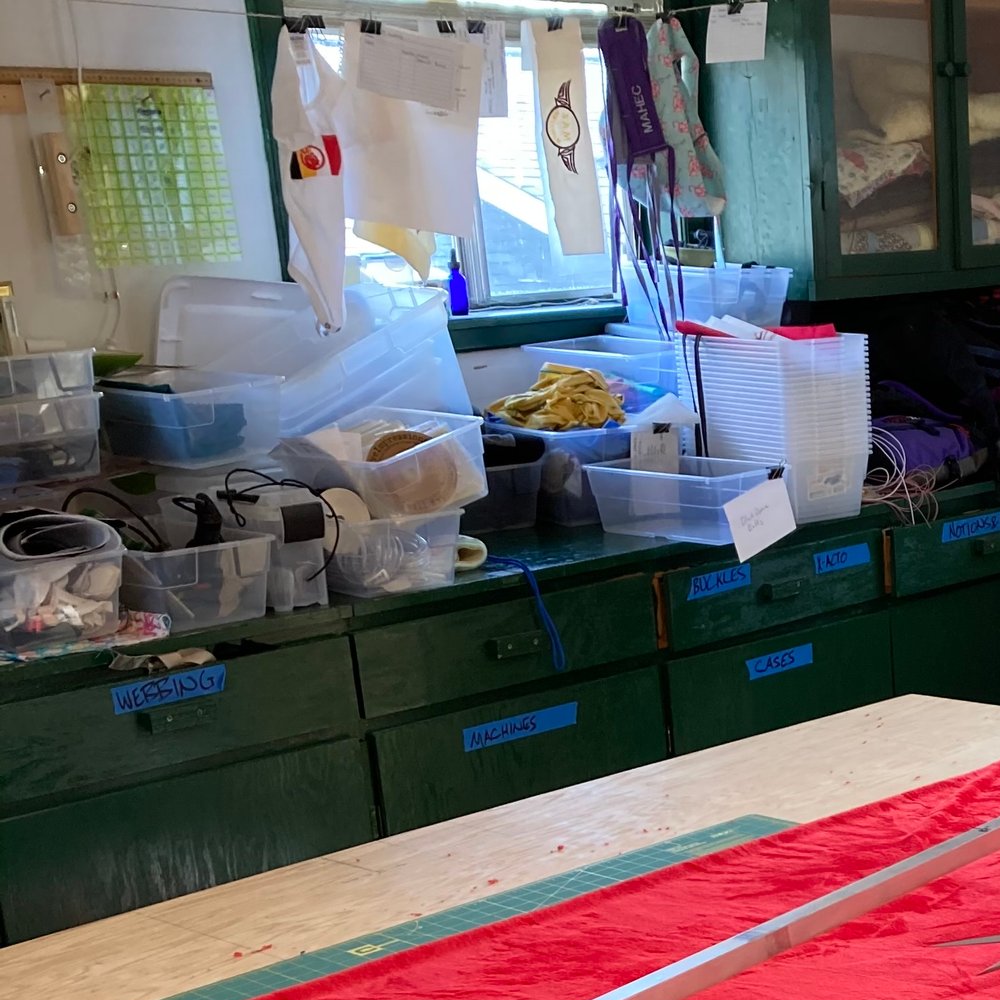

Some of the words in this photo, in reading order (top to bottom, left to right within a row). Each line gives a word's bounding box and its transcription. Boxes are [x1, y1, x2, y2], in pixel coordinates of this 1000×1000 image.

[632, 85, 653, 134] MAHEC
[692, 567, 746, 594] BUCKLES
[754, 650, 795, 673] CASES
[115, 669, 216, 710] WEBBING
[470, 715, 537, 749] MACHINES
